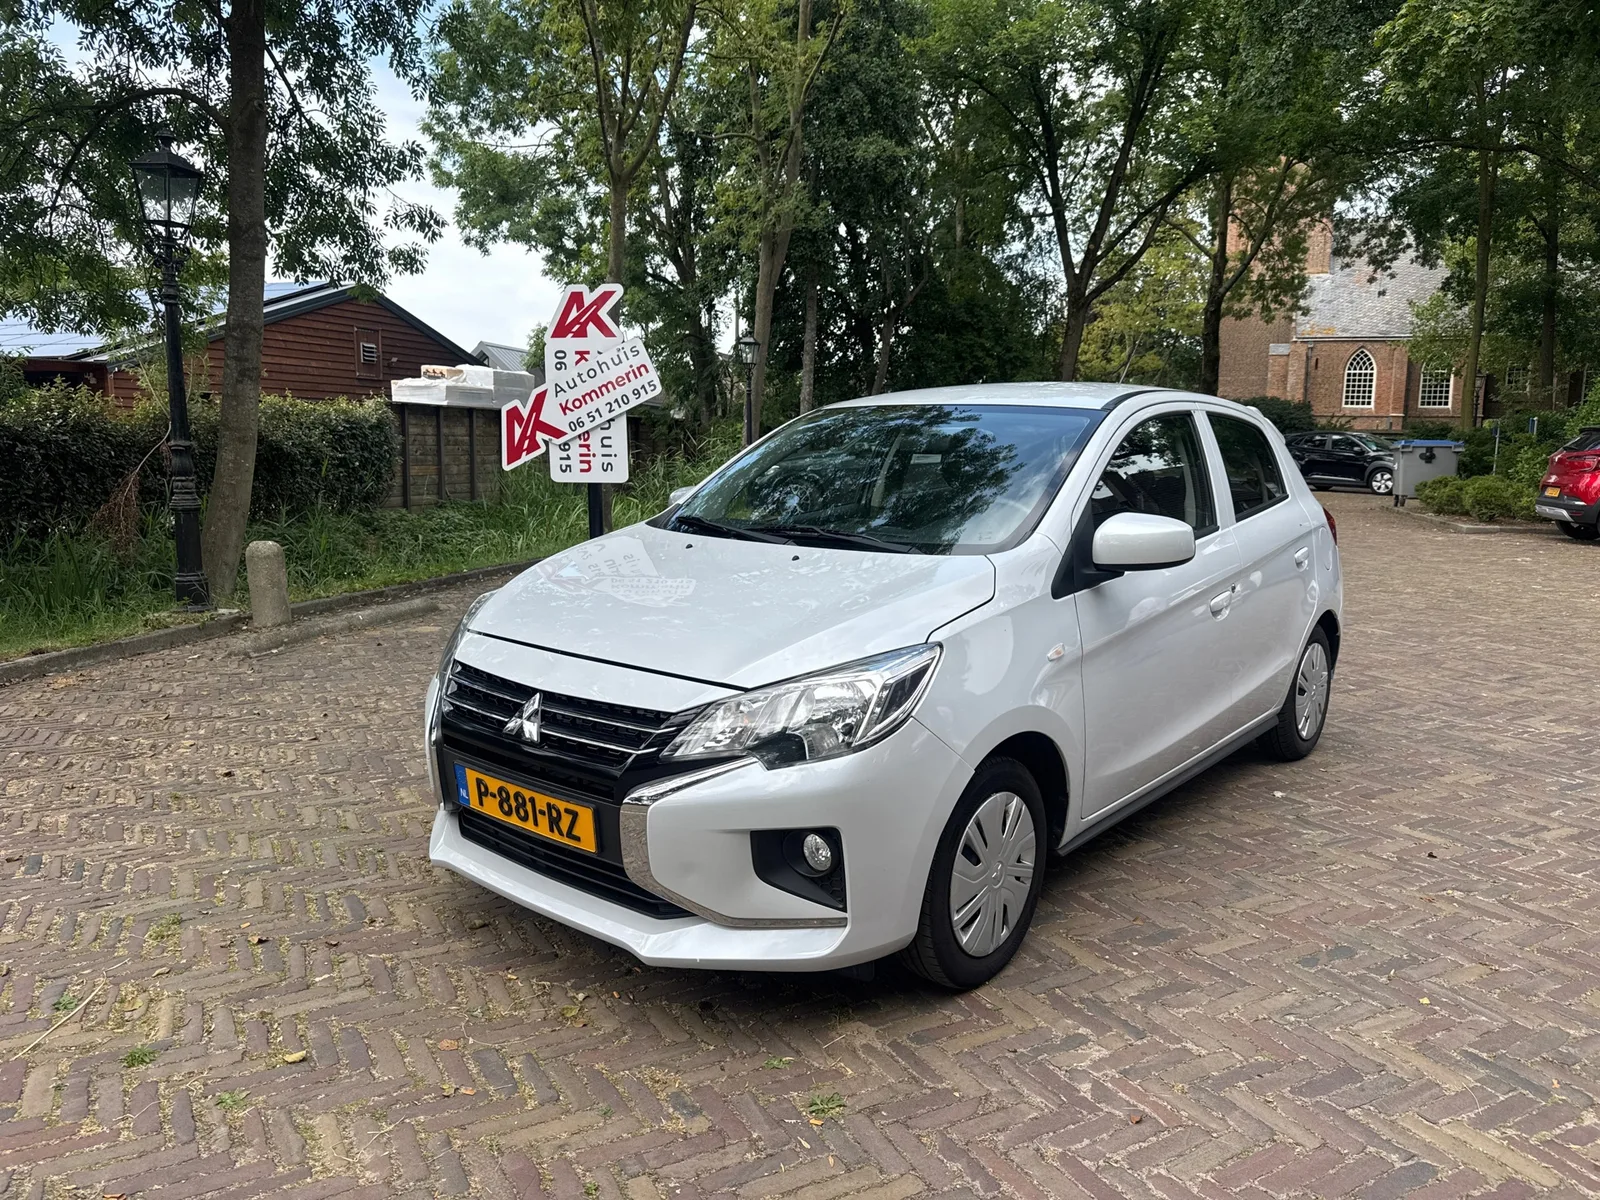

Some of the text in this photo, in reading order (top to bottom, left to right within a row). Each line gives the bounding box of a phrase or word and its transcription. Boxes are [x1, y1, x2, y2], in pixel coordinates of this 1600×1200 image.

[554, 345, 640, 398] Autohuis
[559, 363, 650, 416] Kommerin
[554, 350, 572, 473] 06 915
[568, 379, 657, 432] 06 51 210 915
[460, 787, 469, 799] NL
[475, 777, 581, 842] P-881-RZ
